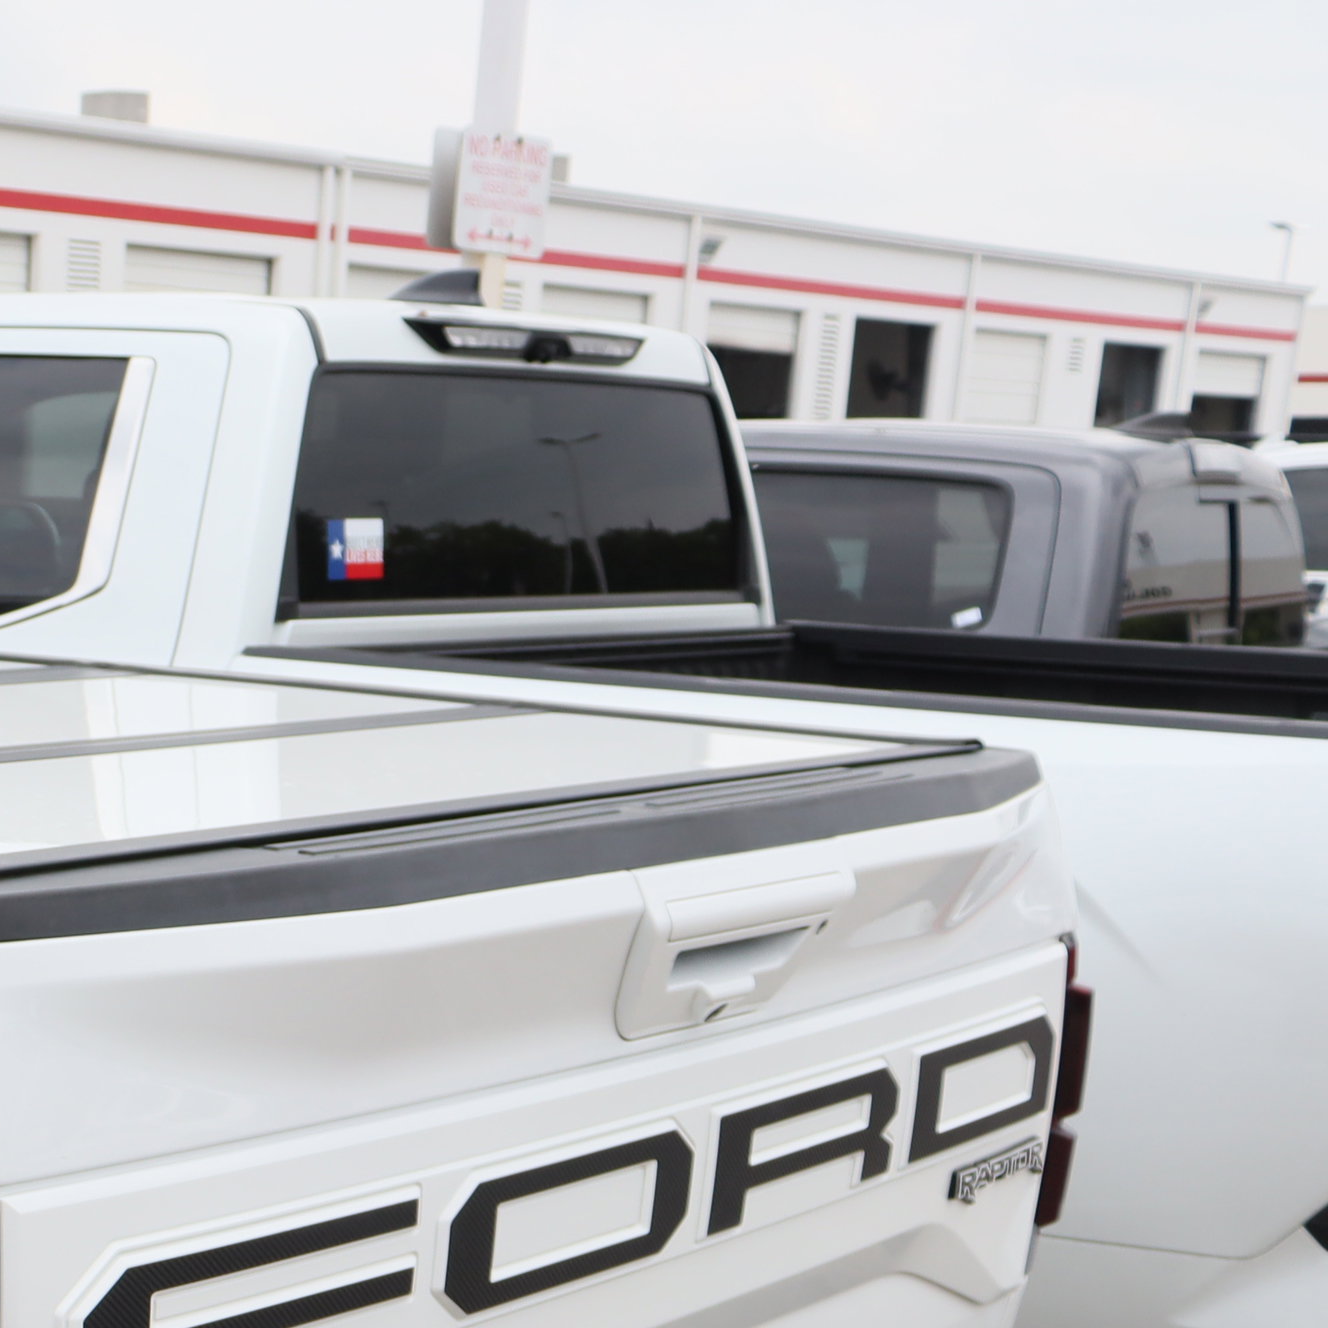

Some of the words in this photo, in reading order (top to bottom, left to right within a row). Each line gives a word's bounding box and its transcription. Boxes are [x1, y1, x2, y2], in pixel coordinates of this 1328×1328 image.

[468, 134, 489, 157] NO
[492, 136, 548, 168] PARKING
[950, 1139, 1044, 1203] RAPTOR
